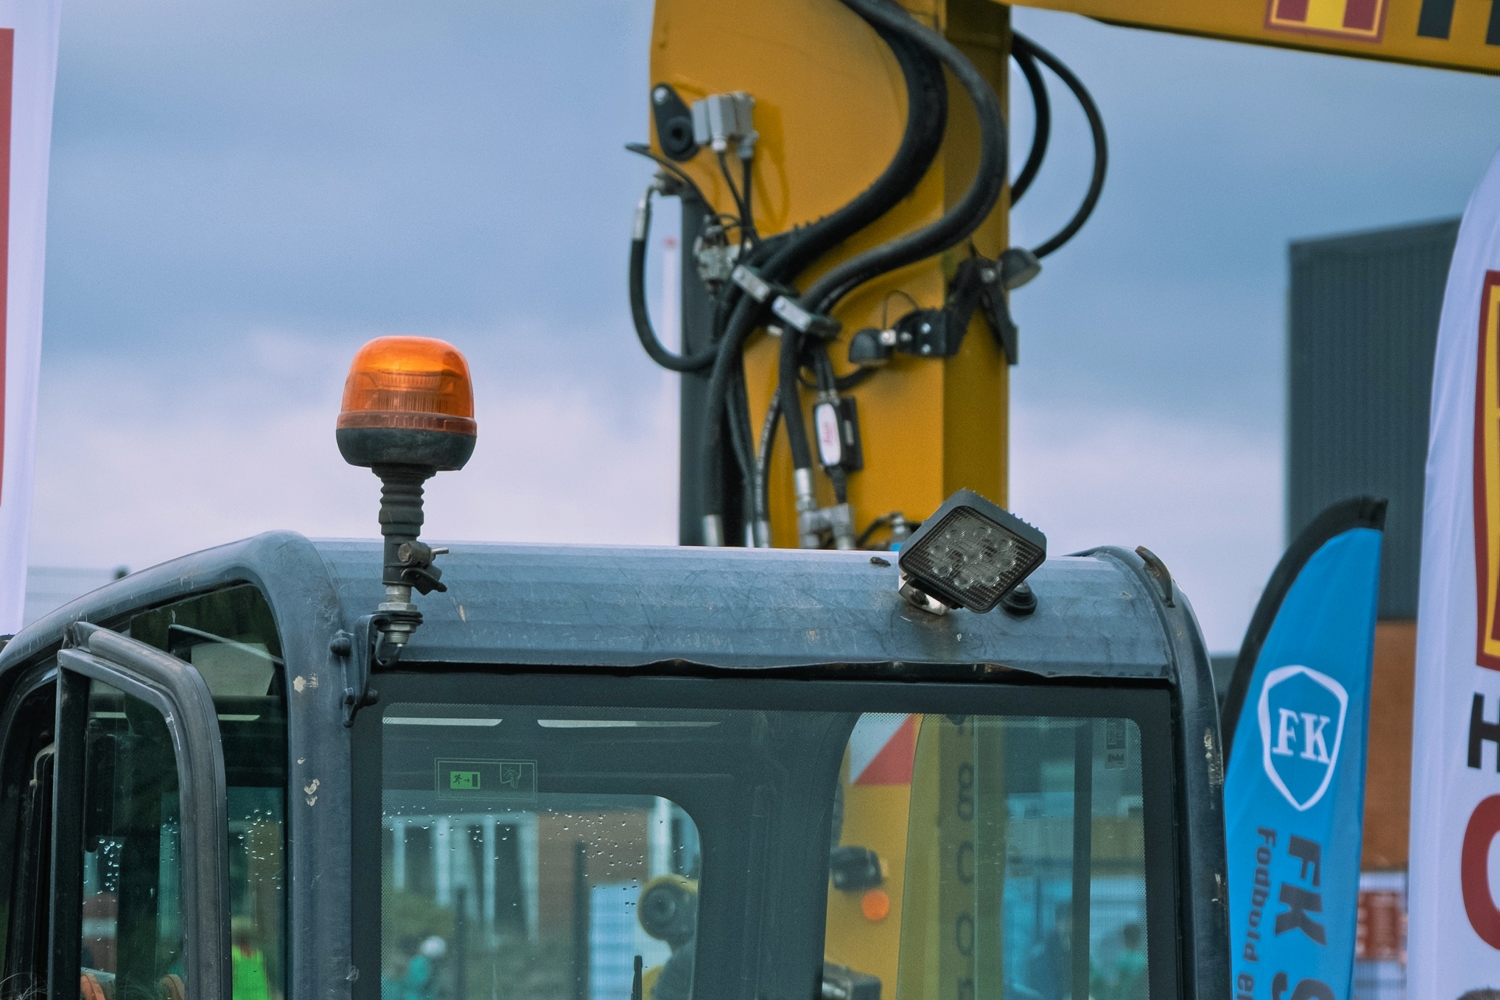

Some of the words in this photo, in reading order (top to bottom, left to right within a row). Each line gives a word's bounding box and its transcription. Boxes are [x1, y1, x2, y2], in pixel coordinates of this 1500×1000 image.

[1272, 707, 1330, 764] FK
[1243, 827, 1277, 962] Fodbold
[1274, 834, 1328, 946] FK
